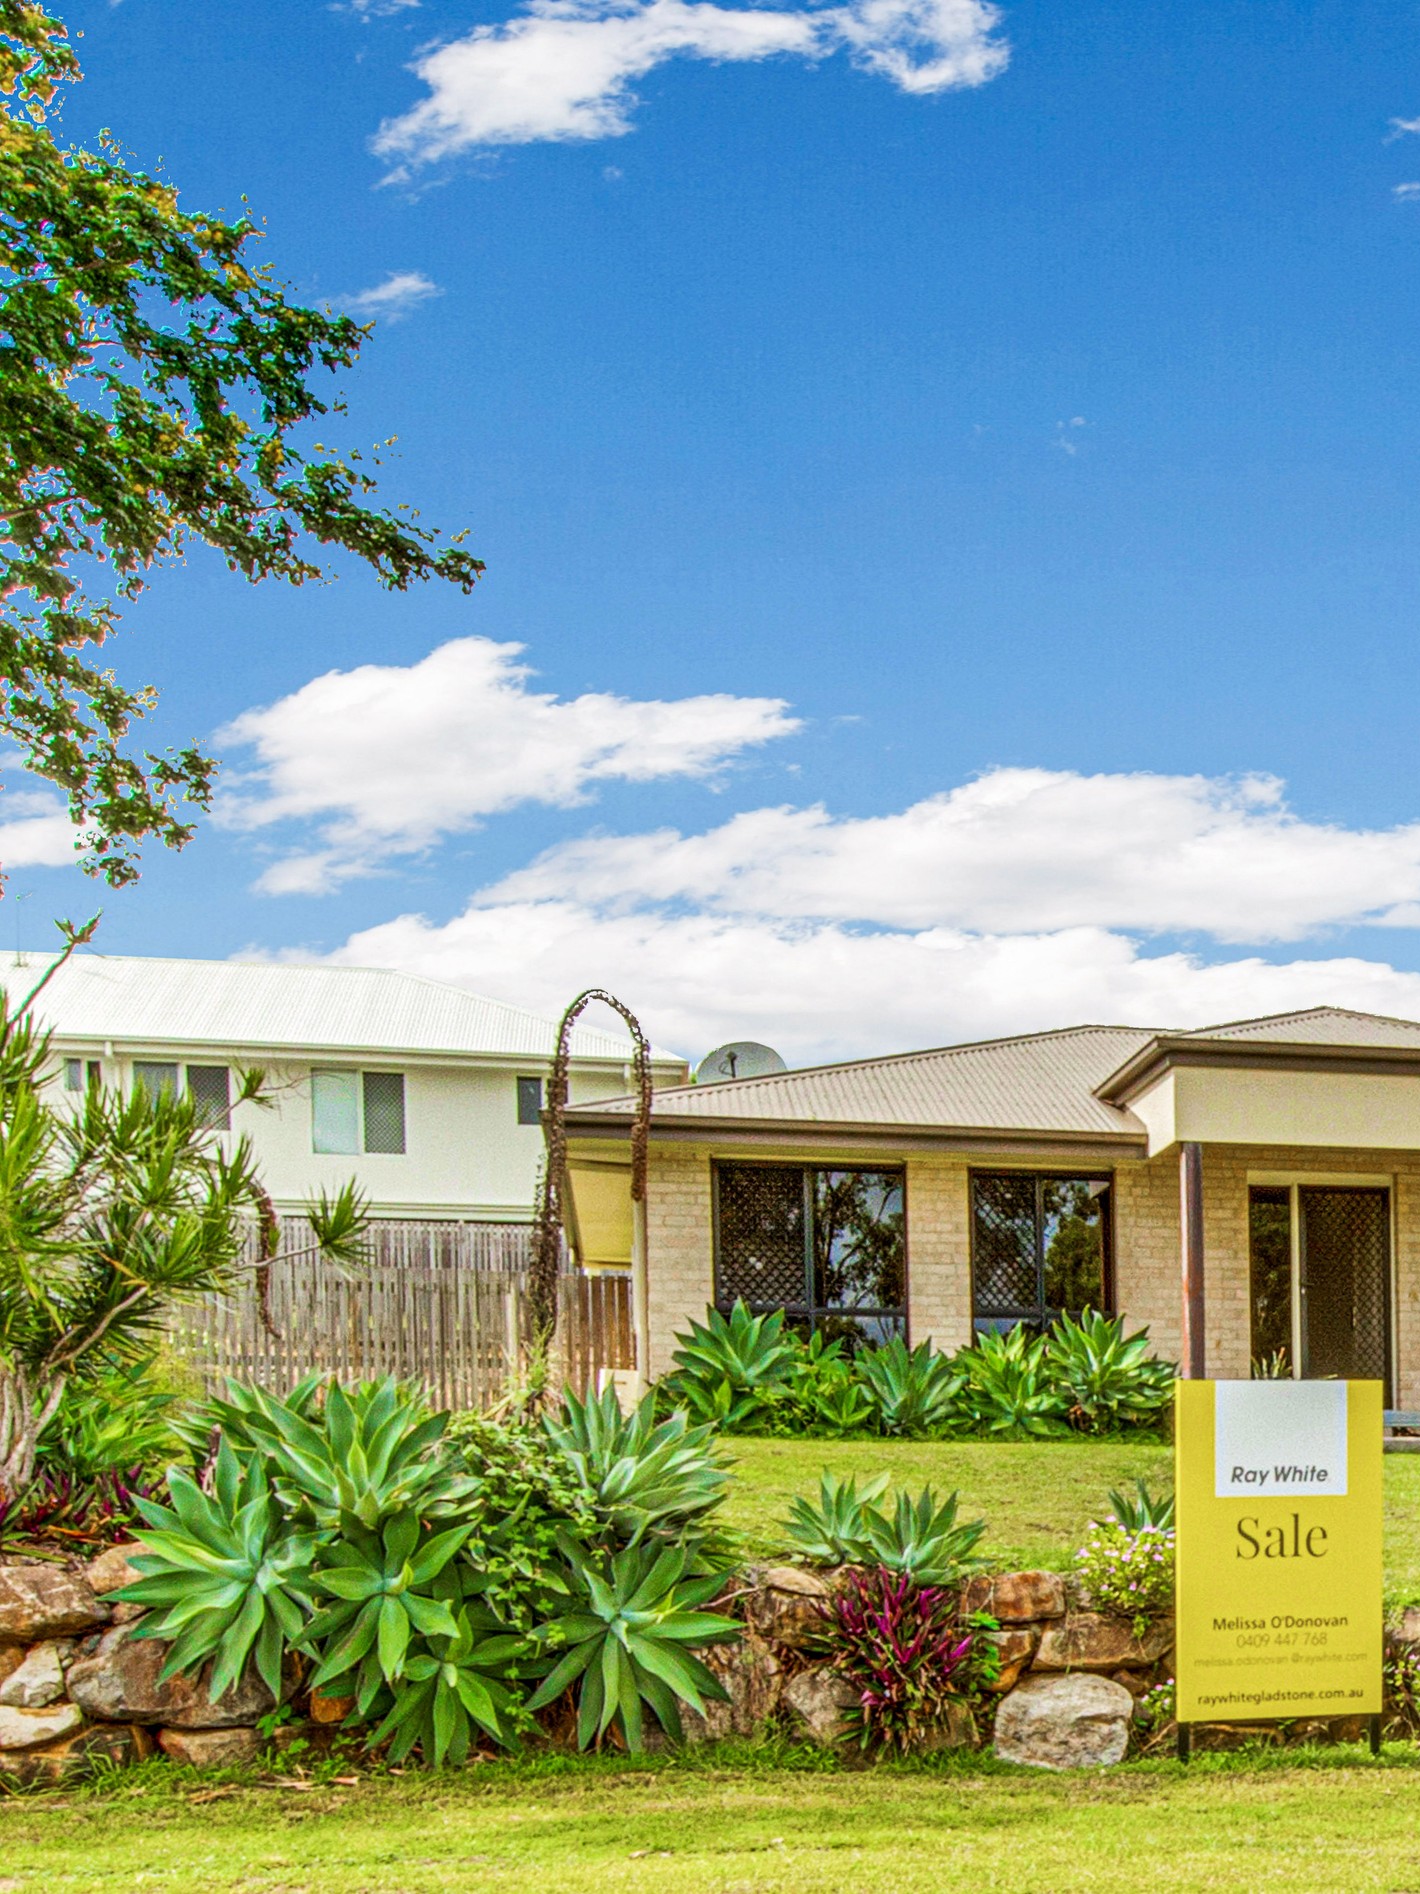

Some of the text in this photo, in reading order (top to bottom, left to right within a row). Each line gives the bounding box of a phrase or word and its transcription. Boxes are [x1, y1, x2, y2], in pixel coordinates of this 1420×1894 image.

[1231, 1465, 1328, 1485] Ray White
[1236, 1512, 1328, 1559] Sale
[1213, 1615, 1347, 1631] Melissa O'Donovan
[1236, 1632, 1328, 1649] 0409 447 768
[1197, 1689, 1364, 1706] raywhitegladstone.com.au
